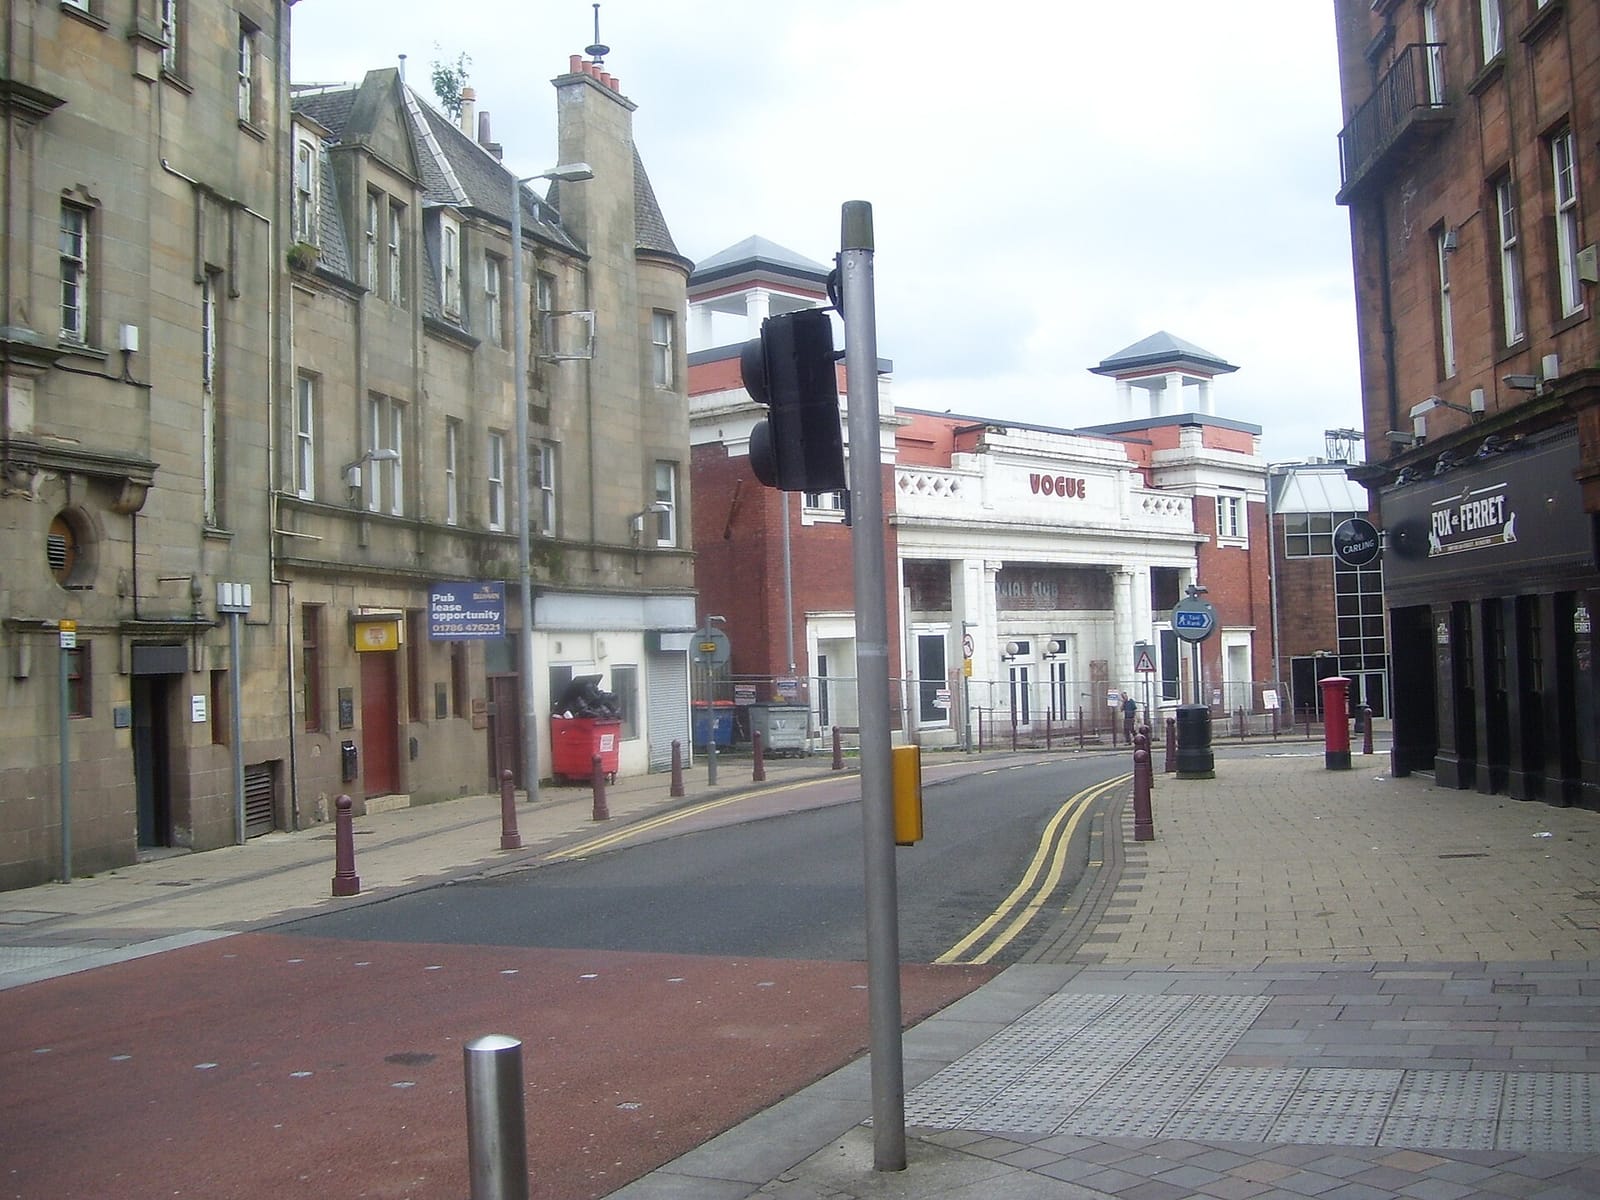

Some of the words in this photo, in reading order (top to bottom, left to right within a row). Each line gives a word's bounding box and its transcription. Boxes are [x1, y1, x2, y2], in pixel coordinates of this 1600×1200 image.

[1029, 473, 1086, 499] VOGUE
[1431, 508, 1453, 537] FOX
[1451, 514, 1460, 526] &
[1459, 494, 1505, 532] FERRET
[1342, 538, 1375, 555] CARLING
[1031, 581, 1058, 597] CLUB
[432, 593, 455, 602] Pub
[432, 603, 462, 611] lease
[432, 610, 500, 621] opportunity
[432, 624, 463, 632] 01786
[465, 623, 500, 632] 476221
